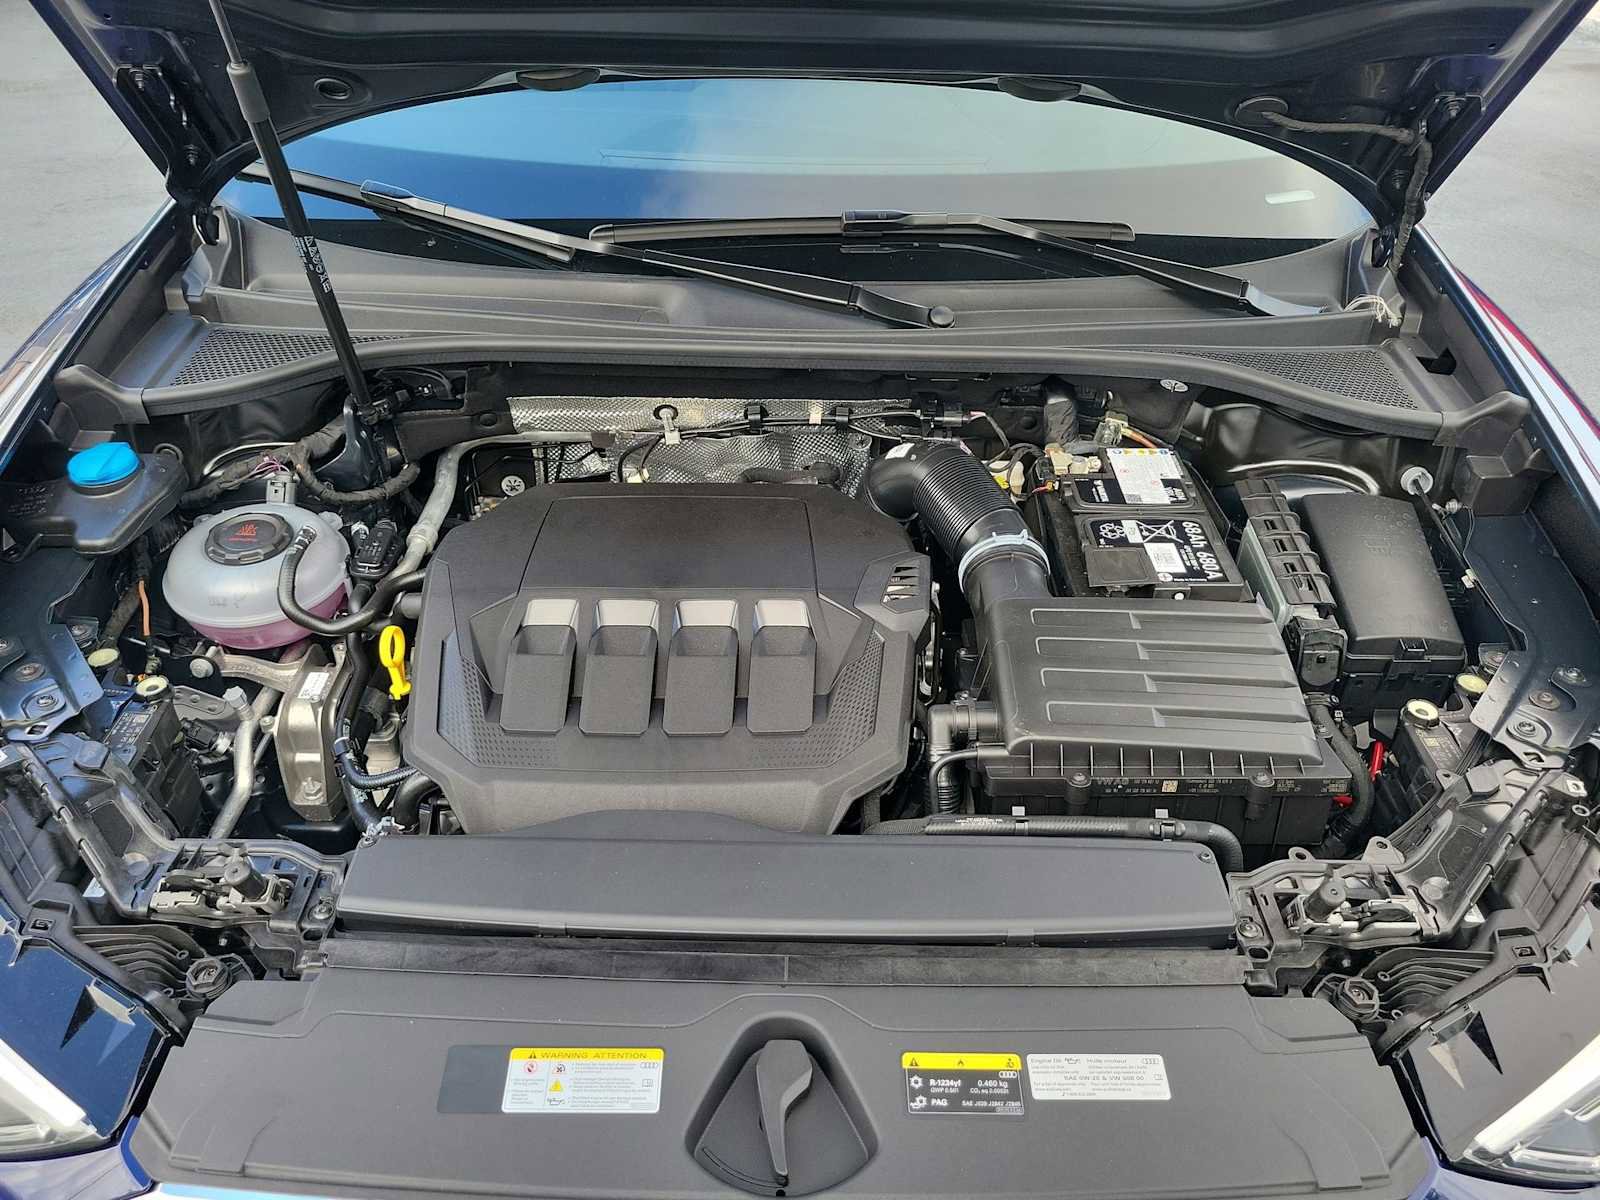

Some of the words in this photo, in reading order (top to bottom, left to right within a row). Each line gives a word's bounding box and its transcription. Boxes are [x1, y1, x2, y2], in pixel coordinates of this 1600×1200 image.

[1182, 521, 1207, 548] 68Ah
[1196, 551, 1223, 579] 680A
[593, 1052, 647, 1060] ATTENTION
[929, 1078, 962, 1088] R-1234yf
[999, 1079, 1008, 1088] kg
[930, 1098, 948, 1106] PAG
